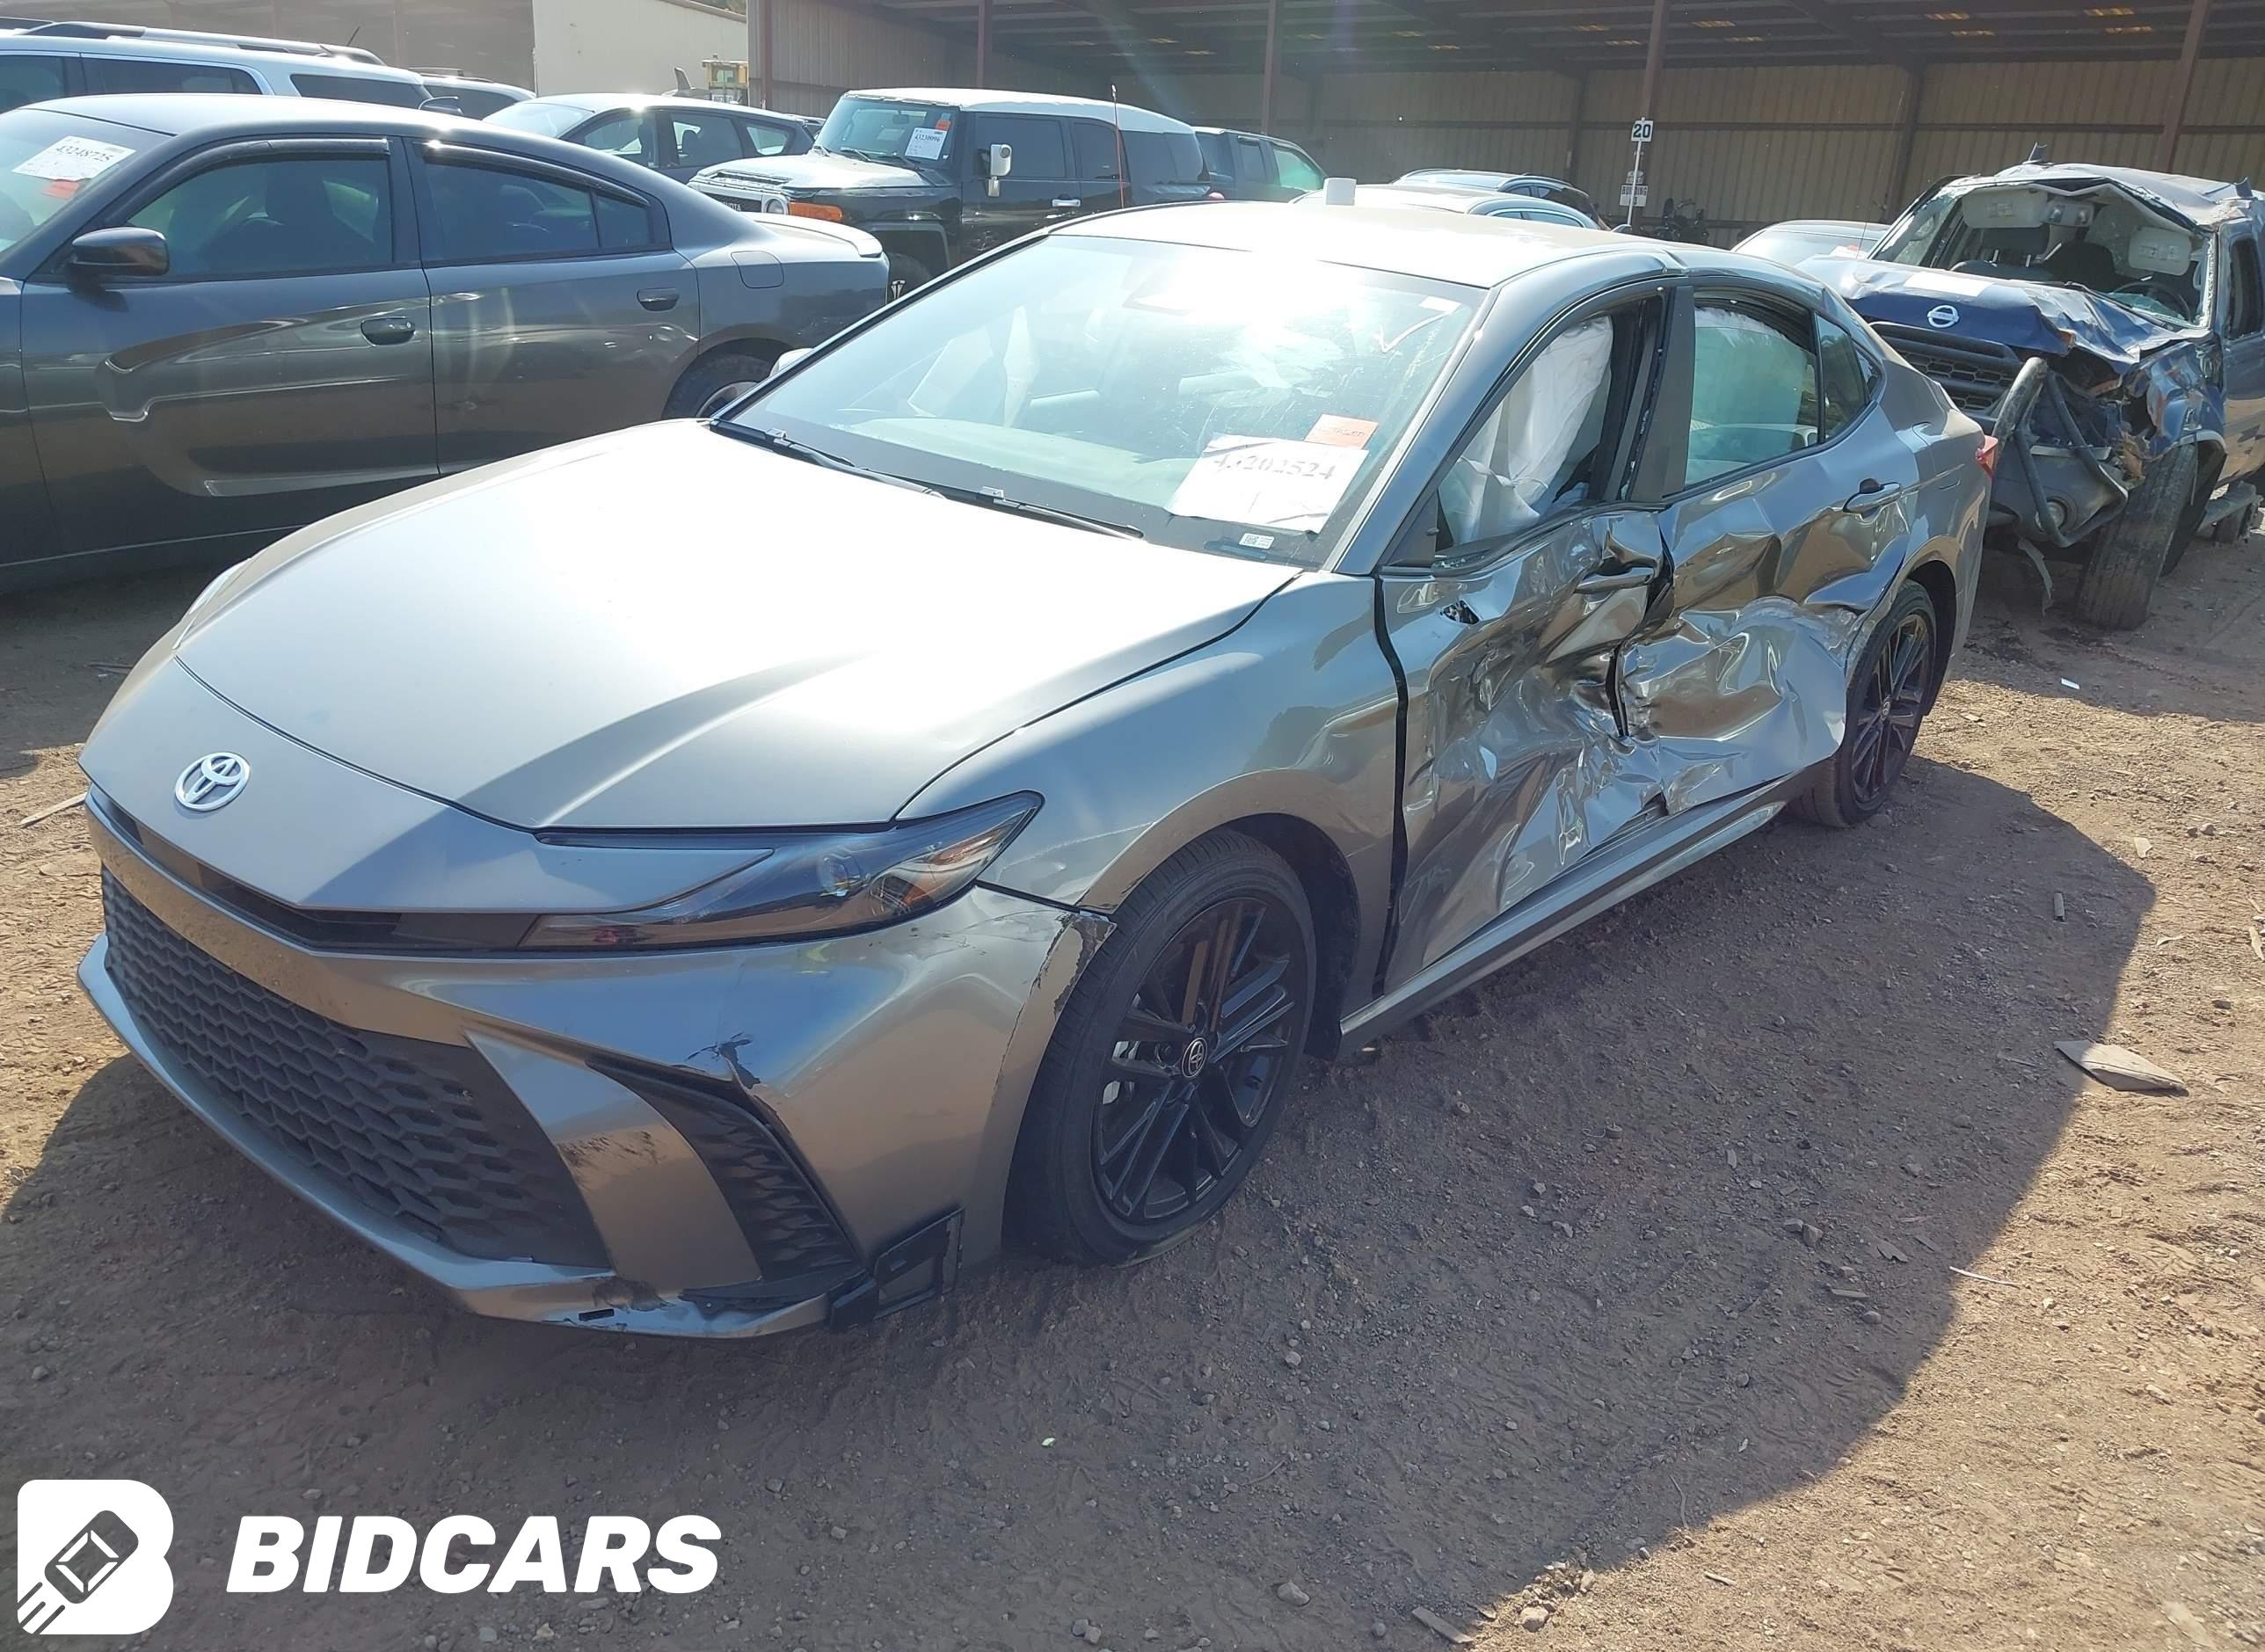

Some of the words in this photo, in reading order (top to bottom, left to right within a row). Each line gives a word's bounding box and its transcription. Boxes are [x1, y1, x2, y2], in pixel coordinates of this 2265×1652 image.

[1633, 124, 1651, 138] 20
[56, 145, 113, 162] 43248725
[1621, 186, 1647, 196] BUIDING
